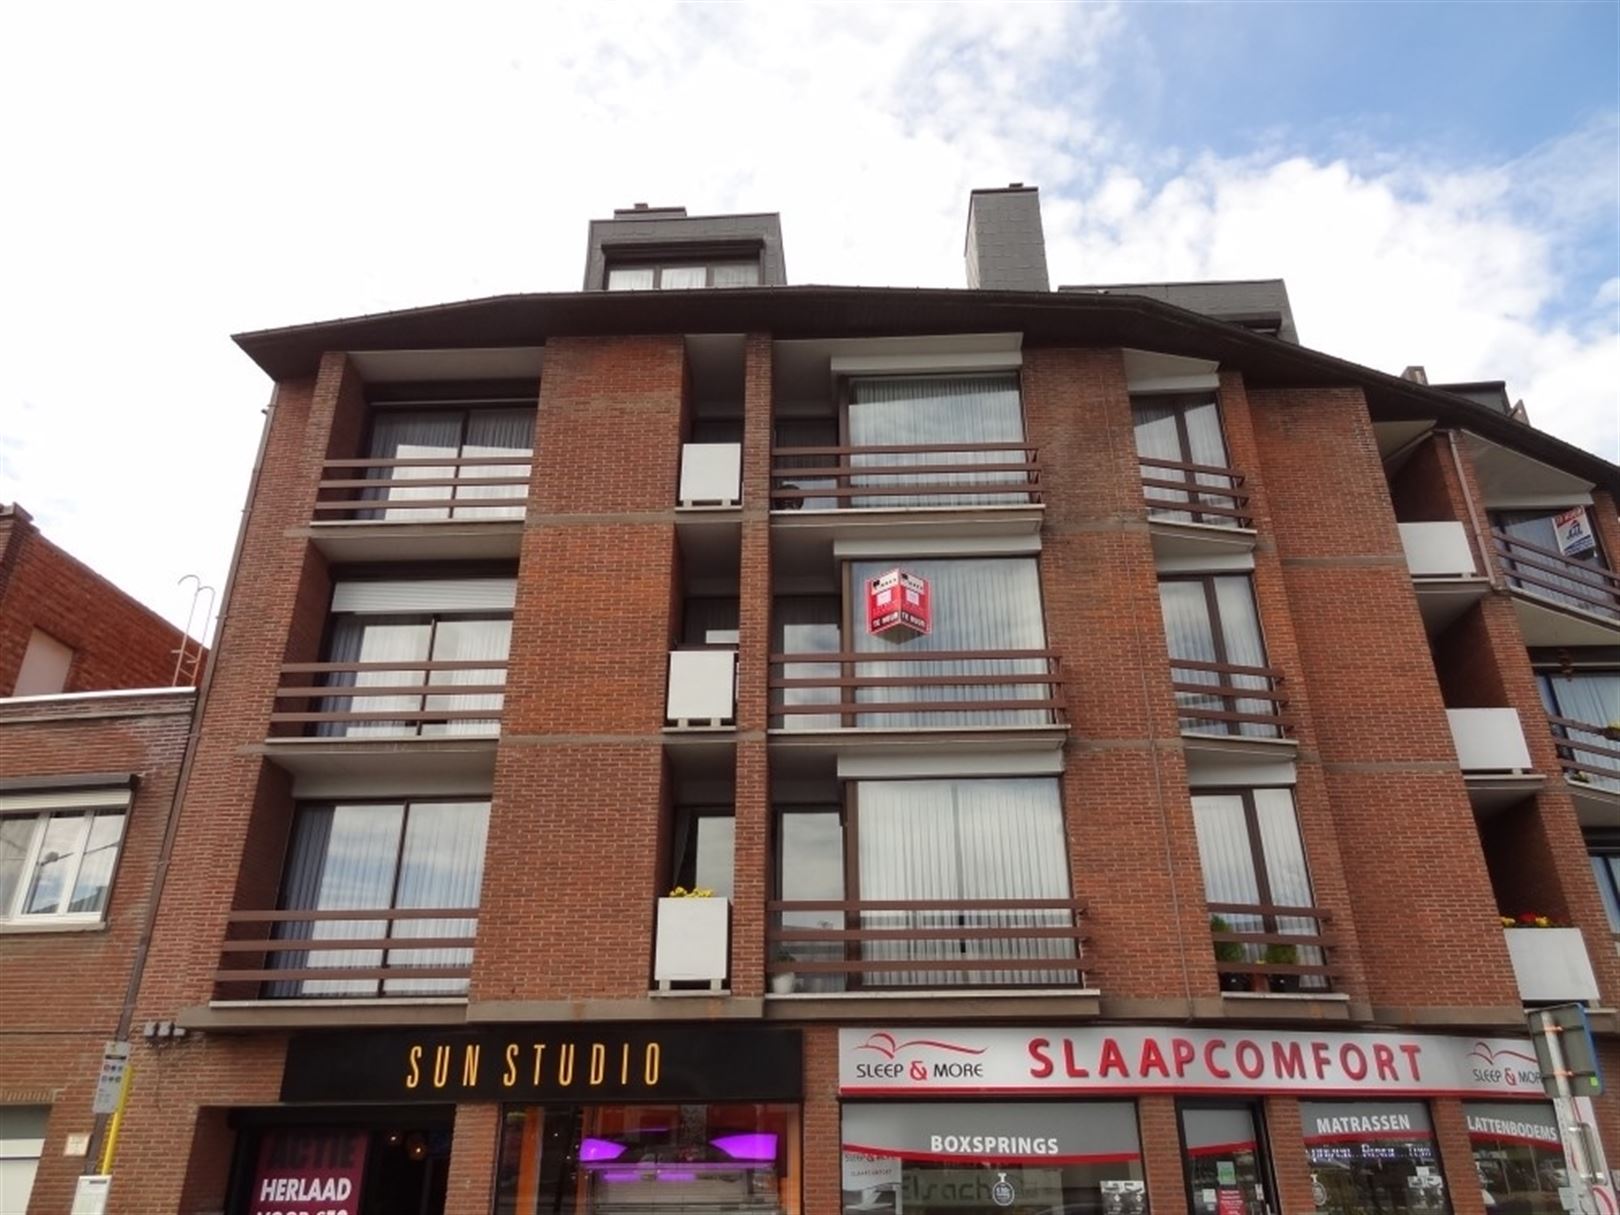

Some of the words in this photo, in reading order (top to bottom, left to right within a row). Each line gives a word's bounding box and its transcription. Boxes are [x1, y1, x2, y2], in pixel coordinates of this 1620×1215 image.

[406, 1045, 480, 1087] SUN
[503, 1043, 660, 1086] STUDIO
[856, 1063, 904, 1078] SLEEP
[910, 1061, 927, 1080] &
[933, 1063, 984, 1078] MORE
[1028, 1038, 1421, 1081] SLAAPCOMFORT
[1472, 1068, 1501, 1083] SLEEP
[1504, 1067, 1517, 1086] &
[1518, 1071, 1543, 1084] MOR
[1316, 1114, 1411, 1134] MATRASSEN
[1466, 1115, 1558, 1141] LATTENBODEMS
[930, 1134, 1059, 1155] BOXSPRINGS
[259, 1177, 353, 1201] HERLAAD
